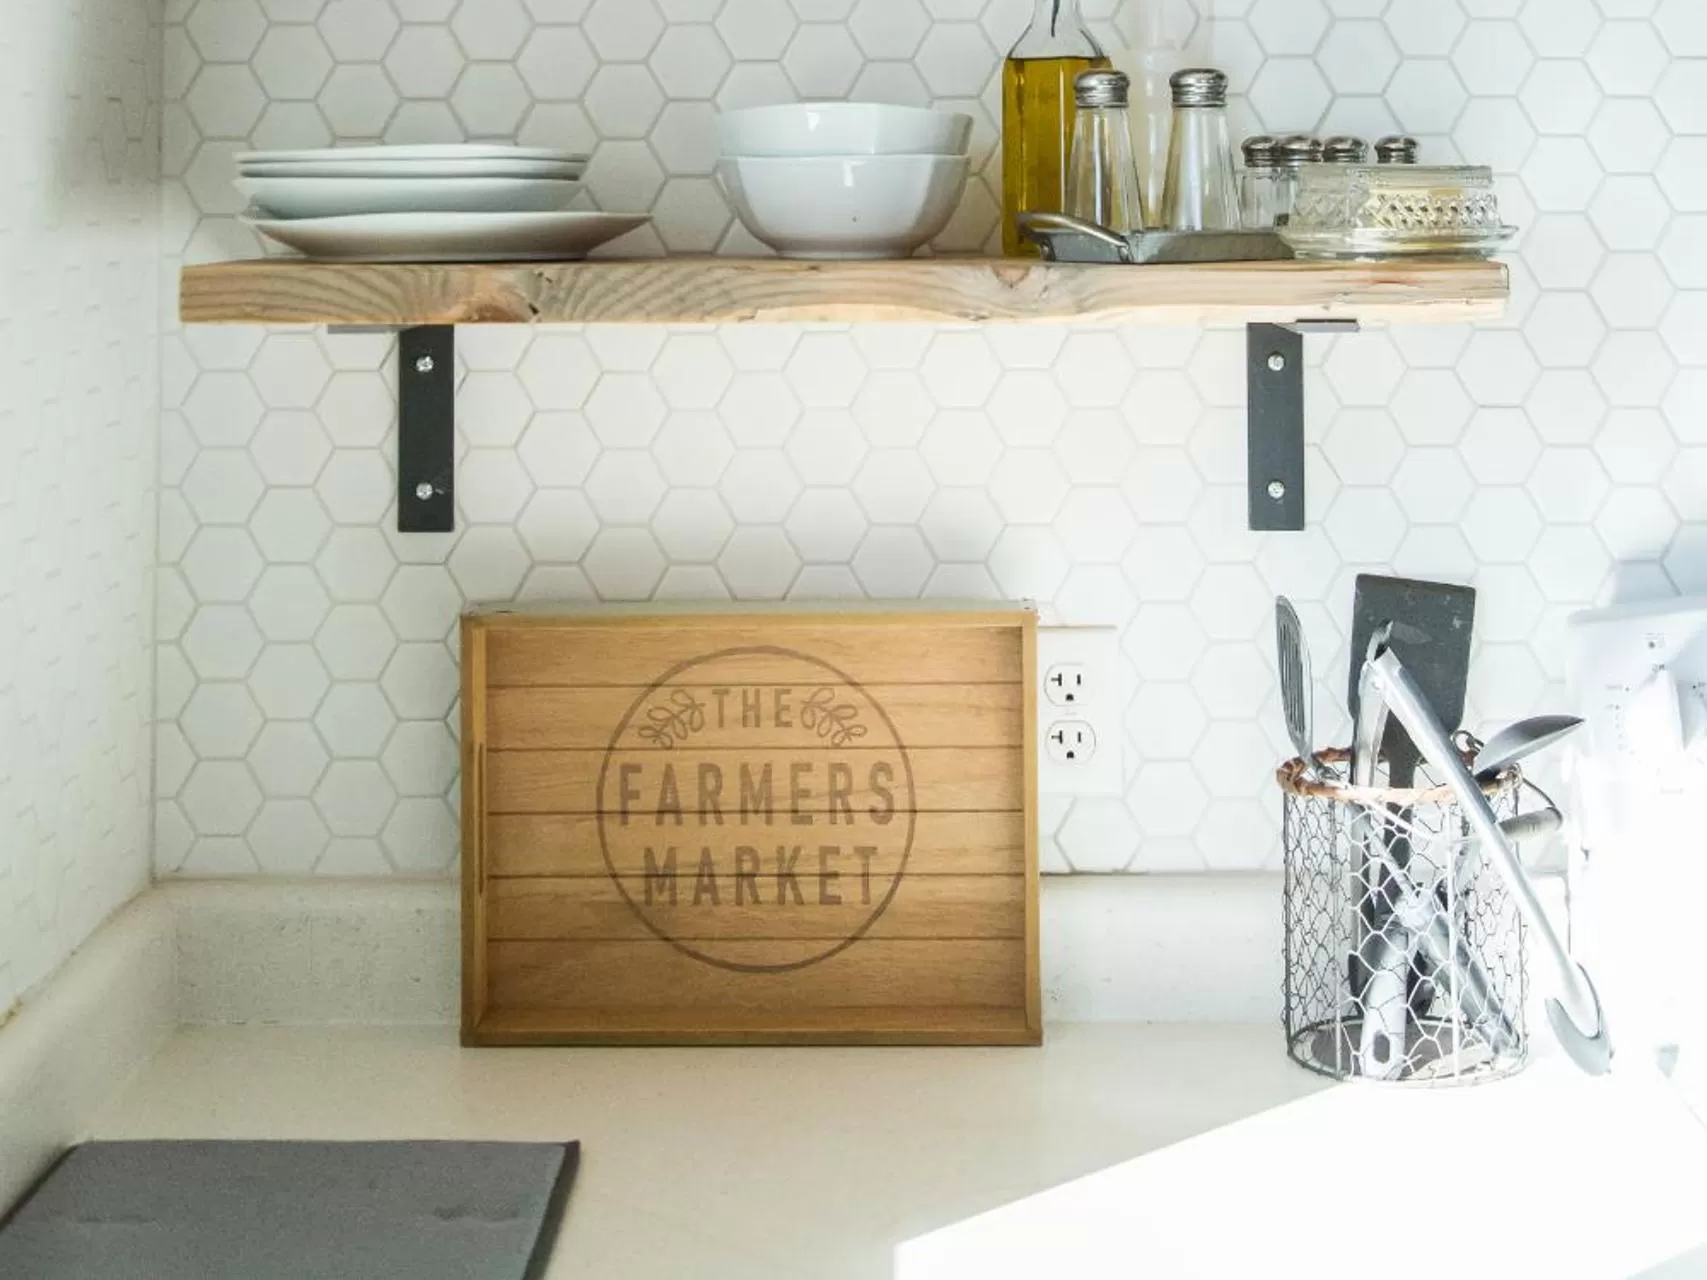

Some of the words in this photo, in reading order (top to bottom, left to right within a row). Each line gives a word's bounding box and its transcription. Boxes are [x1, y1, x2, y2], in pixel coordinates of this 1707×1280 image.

[712, 688, 792, 728] THE
[619, 761, 895, 825] FARMERS
[643, 845, 877, 906] MARKET
